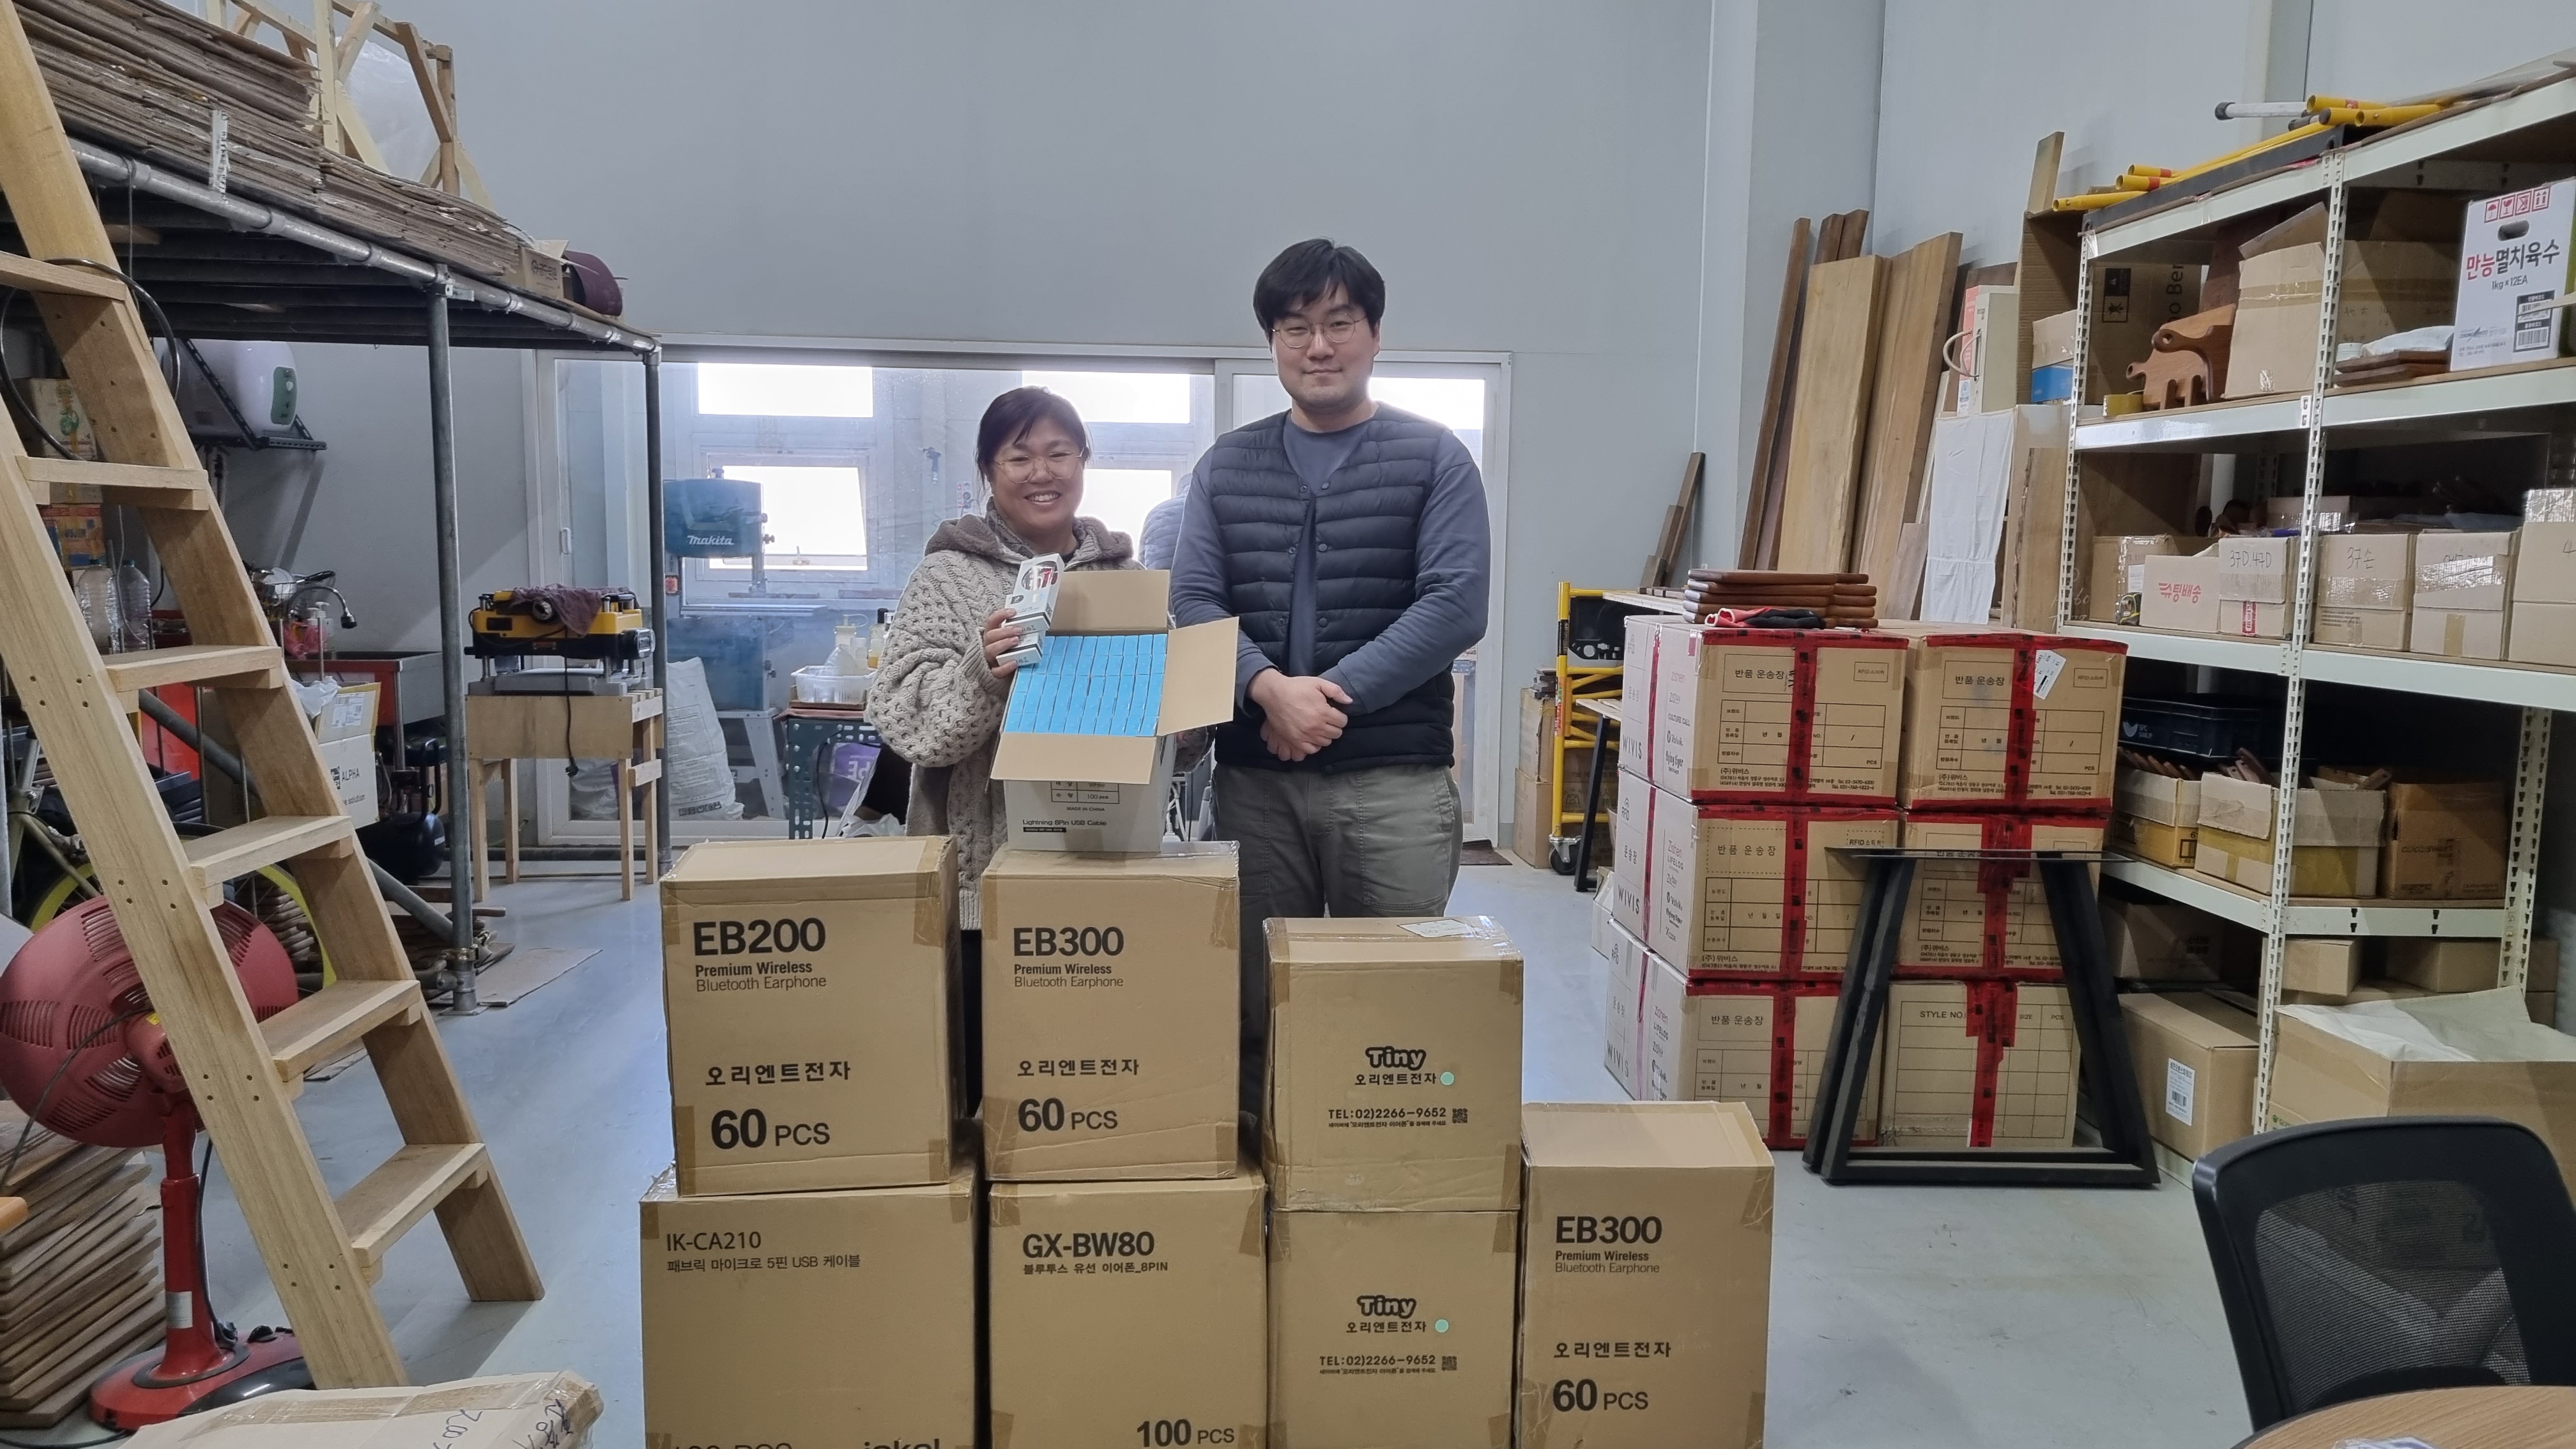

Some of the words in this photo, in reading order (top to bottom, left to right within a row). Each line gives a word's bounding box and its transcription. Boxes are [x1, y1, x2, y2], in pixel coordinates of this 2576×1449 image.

[2466, 239, 2560, 280] 만능멸치육수
[1735, 669, 1753, 679] 반품
[1756, 670, 1784, 680] 운송장
[1955, 675, 1974, 685] 반품
[1976, 676, 2005, 686] 운송장
[1623, 734, 1643, 760] WIVIS
[341, 767, 360, 782] ALPHA
[1022, 818, 1053, 827] Lightning
[1667, 854, 1683, 870] LIFELOG
[1618, 884, 1640, 915] WIVIS
[693, 917, 826, 956] EB200
[1013, 926, 1124, 956] EB300
[695, 963, 752, 977] Premium
[756, 961, 813, 975] Wireless
[1014, 963, 1062, 975] Premium
[1064, 963, 1112, 975] Wireless
[696, 976, 759, 992] Bluetooth
[763, 975, 827, 991] Earphone
[1015, 976, 1067, 988] Bluetooth
[1071, 976, 1124, 989] Earphone
[1711, 1015, 1730, 1025] 반품
[1734, 1015, 1763, 1026] 운송장
[1653, 1021, 1668, 1041] LIFELOG
[1365, 1045, 1427, 1071] Tiny
[1607, 1039, 1629, 1078] WIVIS
[705, 1061, 851, 1086] 오리엔트전자
[1017, 1059, 1139, 1077] 오리엔트전자
[1354, 1073, 1437, 1085] 오리엔트전자
[1018, 1097, 1065, 1132] 60
[1071, 1110, 1118, 1130] PCS
[710, 1108, 767, 1149] 60
[775, 1123, 831, 1146] PCS
[1556, 1216, 1662, 1244] EB300
[666, 1231, 762, 1252] IK-CA210
[1022, 1231, 1155, 1258] GX-BW80
[667, 1258, 706, 1273] 패브릭
[710, 1257, 763, 1271] 마이크로
[767, 1256, 788, 1269] 5핀
[792, 1255, 818, 1268] USB
[823, 1254, 861, 1268] 케이블
[1556, 1250, 1600, 1261] Premium
[1604, 1250, 1649, 1261] Wireless
[1023, 1263, 1068, 1275] 블루투스
[1073, 1262, 1096, 1274] 유선
[1102, 1261, 1168, 1274] 이어폰_8PIN
[1555, 1262, 1606, 1273] Bluetooth
[1609, 1262, 1660, 1275] Earphone
[1356, 1294, 1417, 1319] Tiny
[1346, 1321, 1427, 1333] 오리엔트전자
[1554, 1342, 1671, 1358] 오리엔트전자
[1552, 1378, 1597, 1412] 60
[1604, 1392, 1649, 1411] PCS
[1137, 1418, 1192, 1448] 100
[1197, 1428, 1235, 1445] PCS
